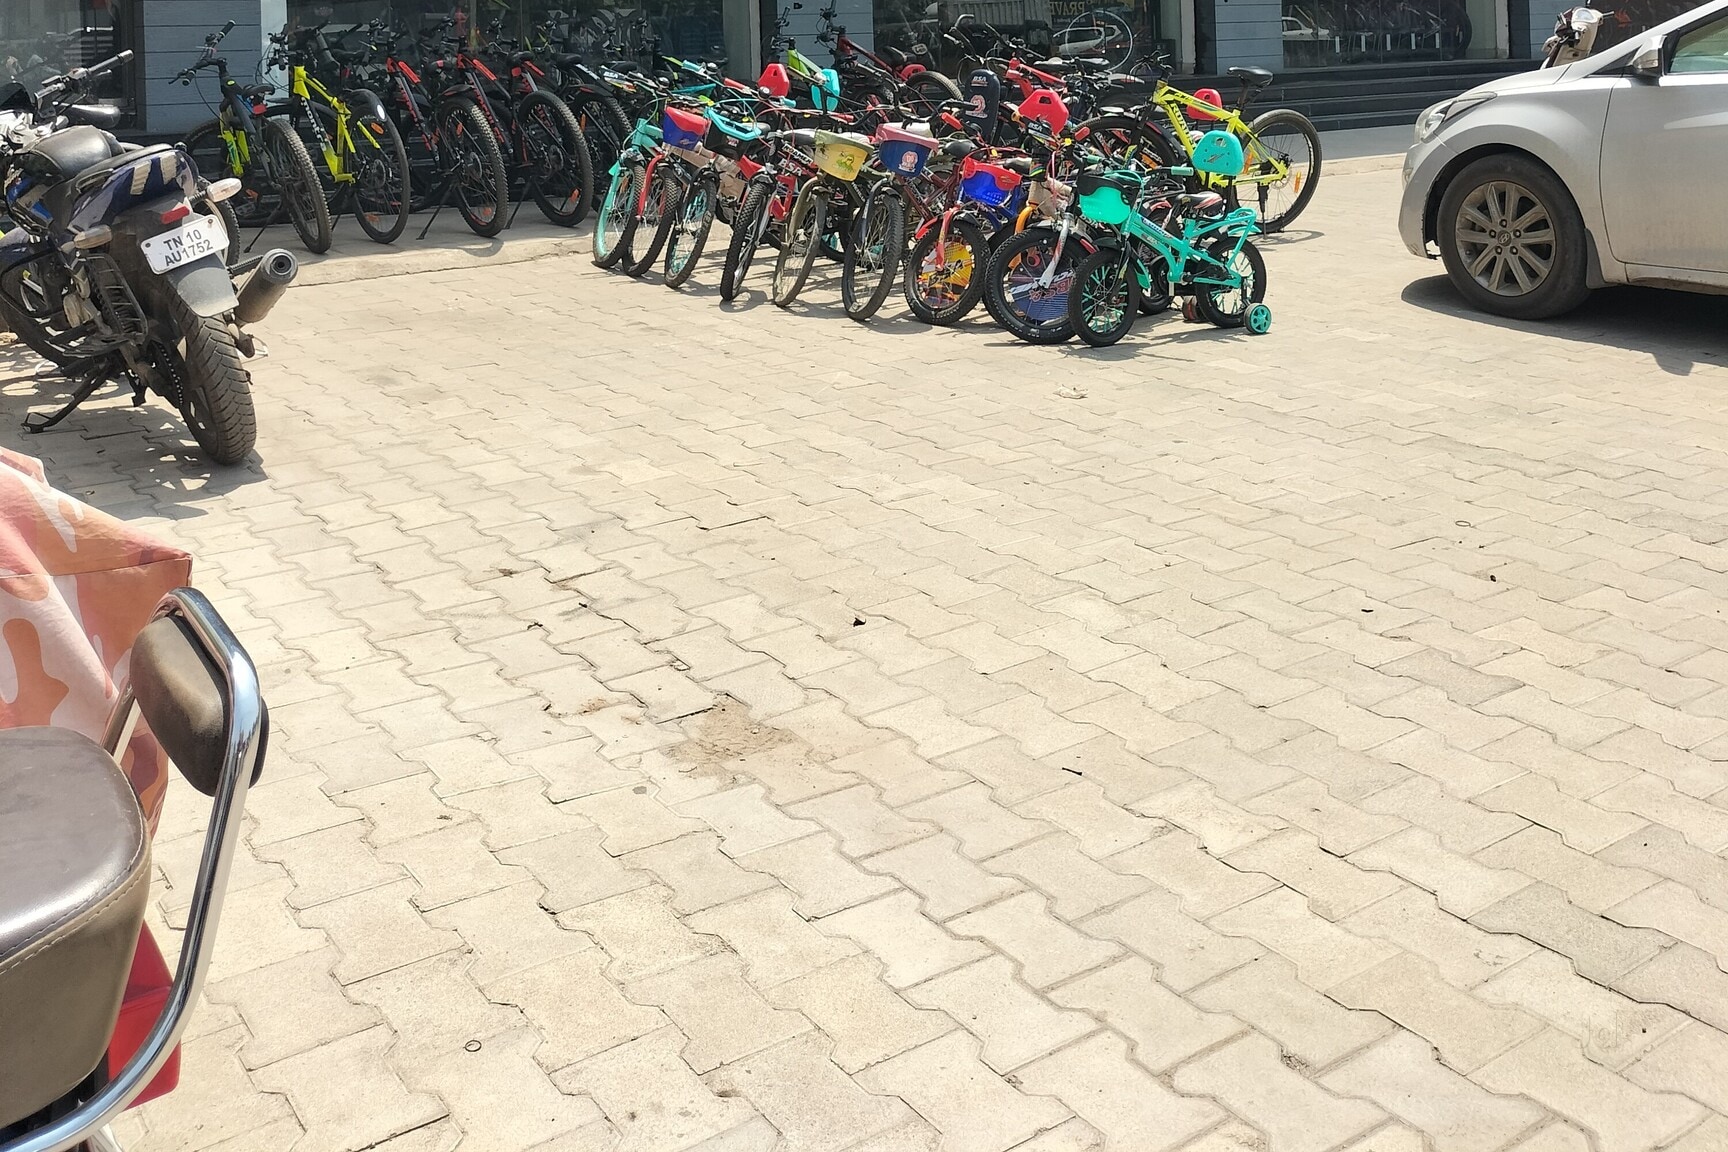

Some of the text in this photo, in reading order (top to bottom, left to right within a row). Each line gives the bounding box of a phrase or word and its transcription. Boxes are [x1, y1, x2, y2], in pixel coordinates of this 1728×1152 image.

[777, 158, 803, 177] BSA
[163, 229, 202, 250] TN 10
[164, 239, 214, 266] AU1752
